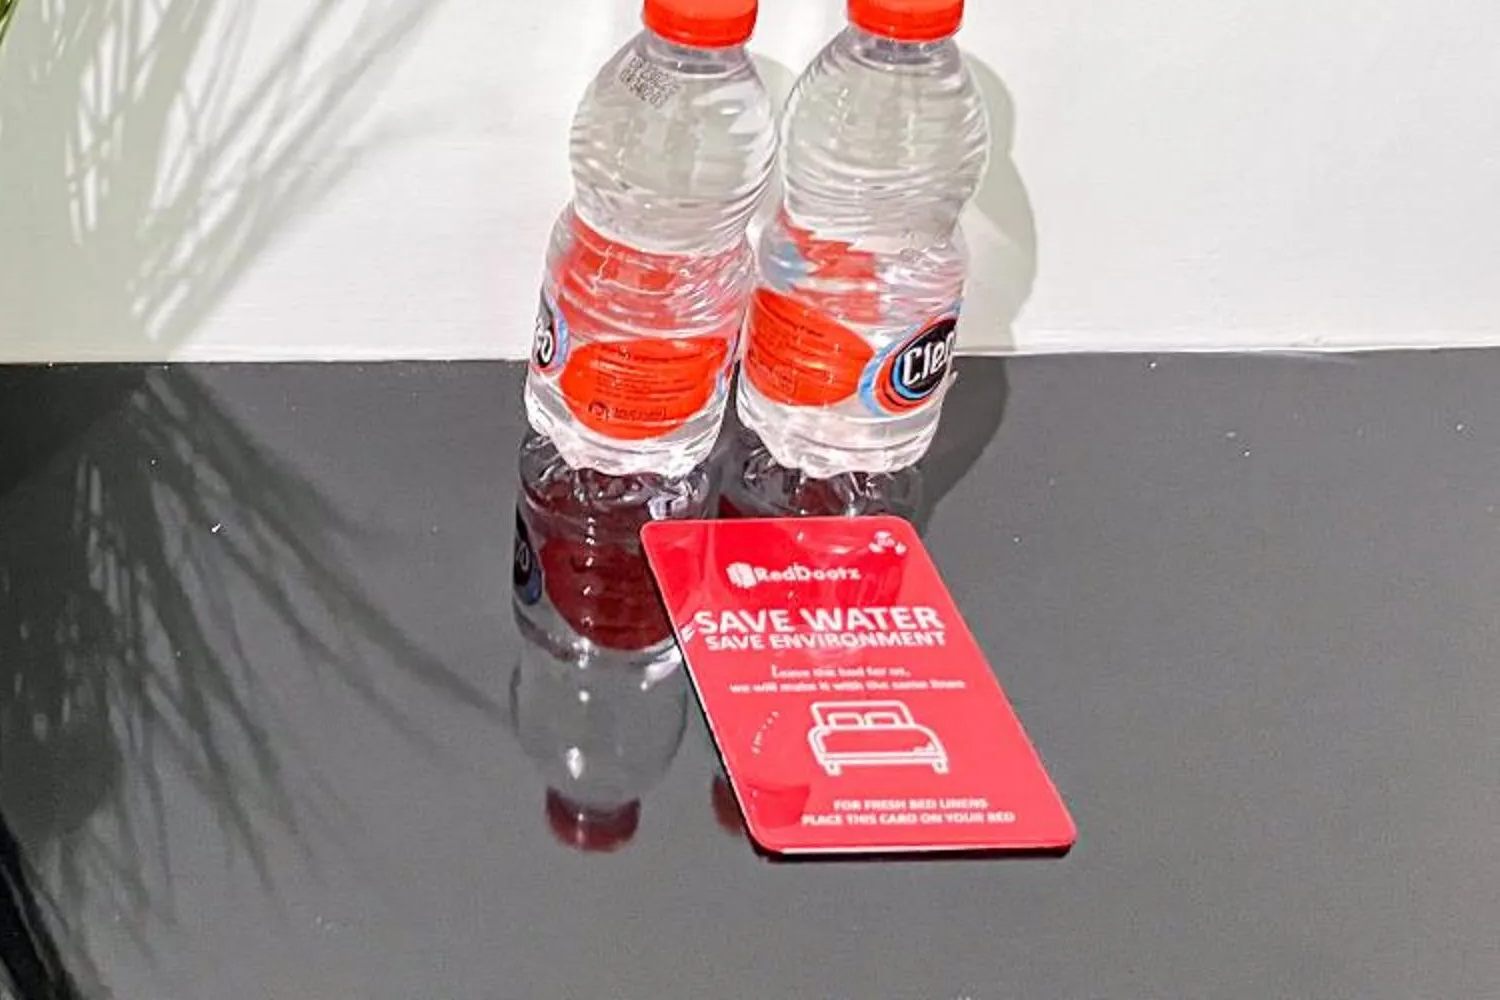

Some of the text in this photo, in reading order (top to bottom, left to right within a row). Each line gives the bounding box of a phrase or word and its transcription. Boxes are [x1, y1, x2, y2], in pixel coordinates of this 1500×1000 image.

[694, 605, 945, 634] SAVE WATER
[704, 631, 946, 651] SAVE ENVIRONMENT
